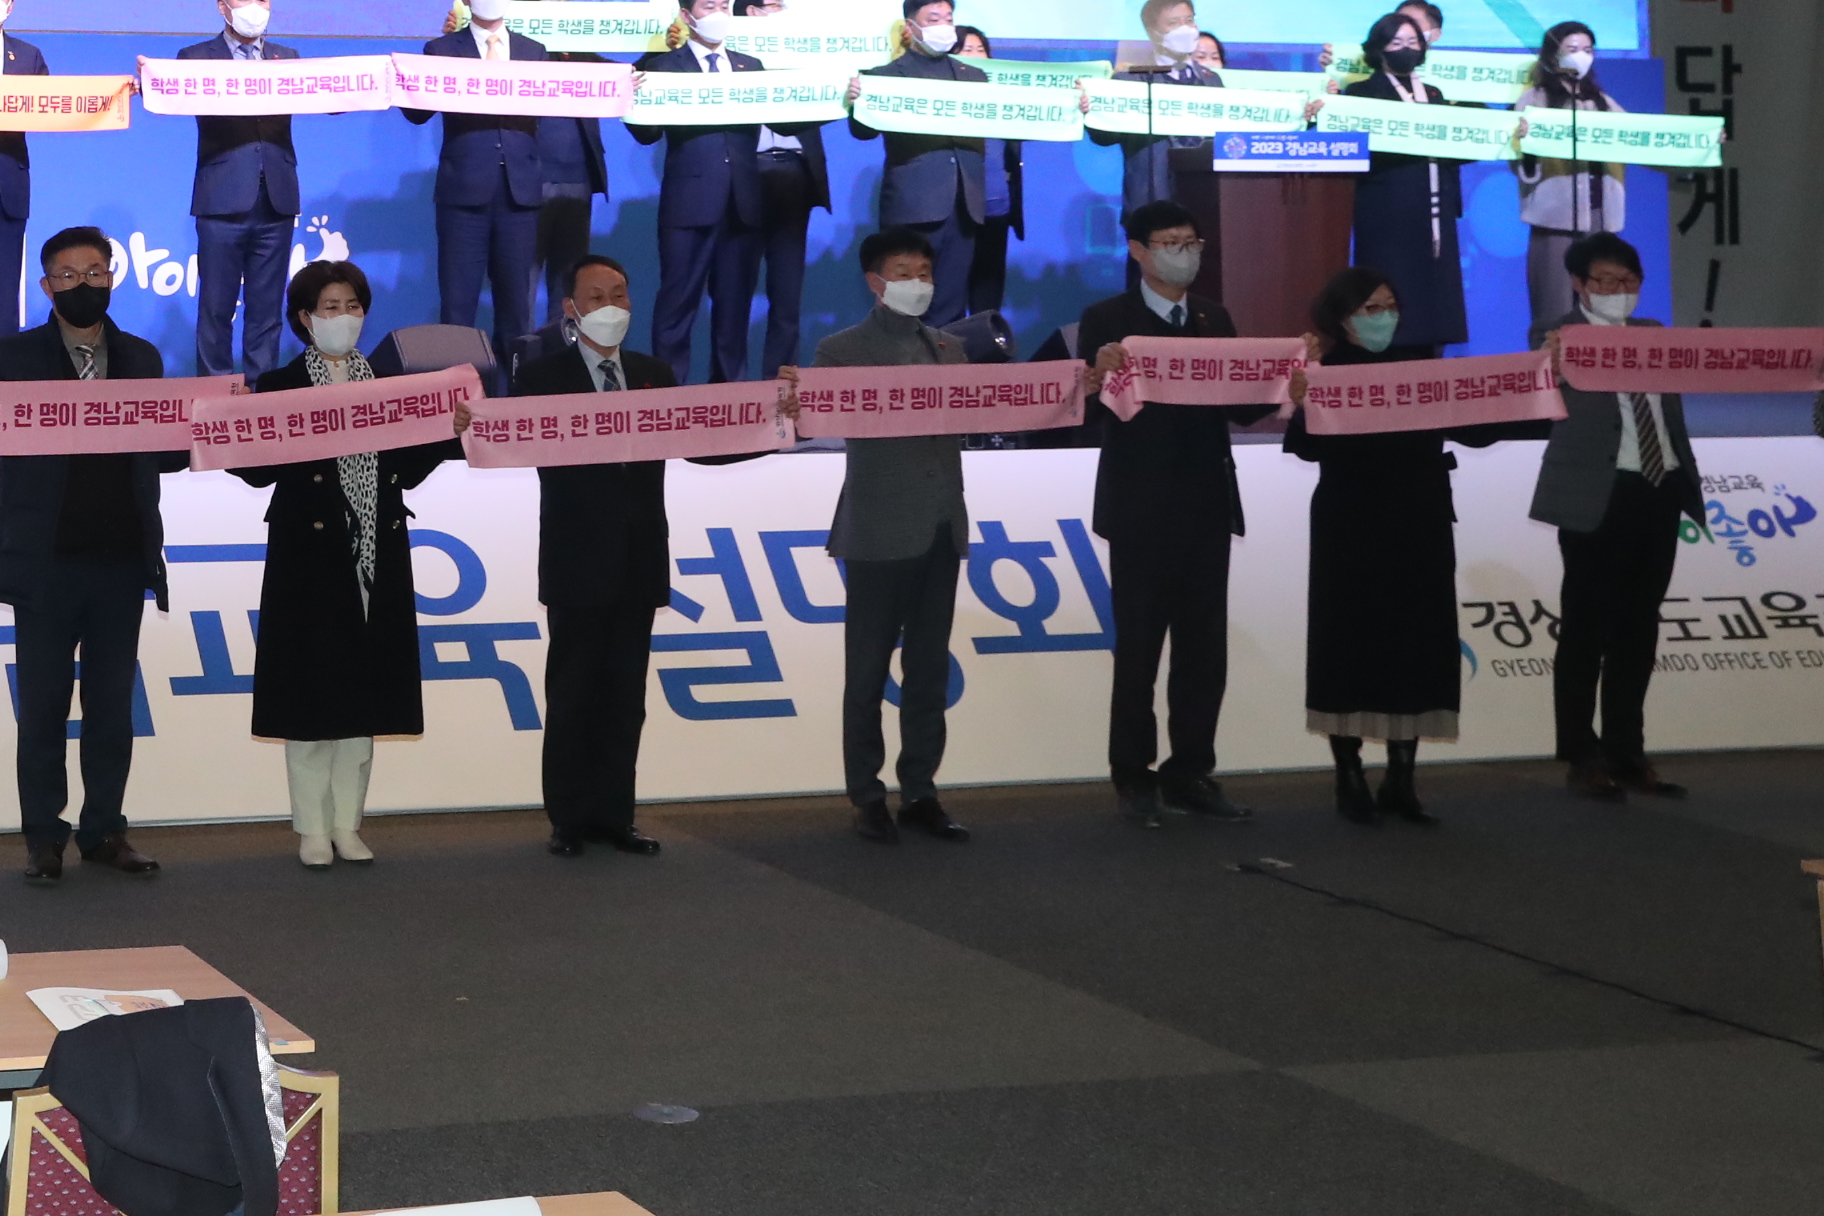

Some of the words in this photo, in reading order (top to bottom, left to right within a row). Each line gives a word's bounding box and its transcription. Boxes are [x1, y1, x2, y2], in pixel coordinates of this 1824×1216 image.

[277, 74, 378, 96] 경남교육입니다.
[518, 79, 621, 98] 경남교육입니다.
[38, 95, 72, 114] 모두를
[76, 94, 113, 114] 이롭게!
[865, 94, 928, 115] 경남교육은
[932, 99, 957, 117] 모든
[961, 102, 997, 120] 학생을
[1002, 104, 1065, 122] 챙겨갑니다.
[1704, 348, 1814, 370] 경남교육입니다.
[799, 390, 834, 413] 학생
[839, 389, 857, 412] 한
[862, 388, 884, 414] 명,
[888, 388, 906, 411] 한
[911, 386, 943, 410] 명이
[948, 382, 1067, 409] 경남교육입니다.
[14, 403, 33, 428] 한
[39, 402, 77, 427] 명이
[191, 420, 231, 446] 학생
[233, 418, 254, 443] 한
[257, 415, 283, 442] 명,
[286, 413, 305, 438] 한
[310, 408, 346, 435] 명이
[472, 419, 510, 443] 학생
[516, 418, 534, 442] 한
[540, 416, 565, 442] 명,
[571, 414, 589, 438] 한
[595, 411, 631, 436] 명이
[637, 401, 767, 433] 경남교육입니다.
[1702, 652, 1772, 672] OFFICE
[1775, 650, 1795, 671] OF
